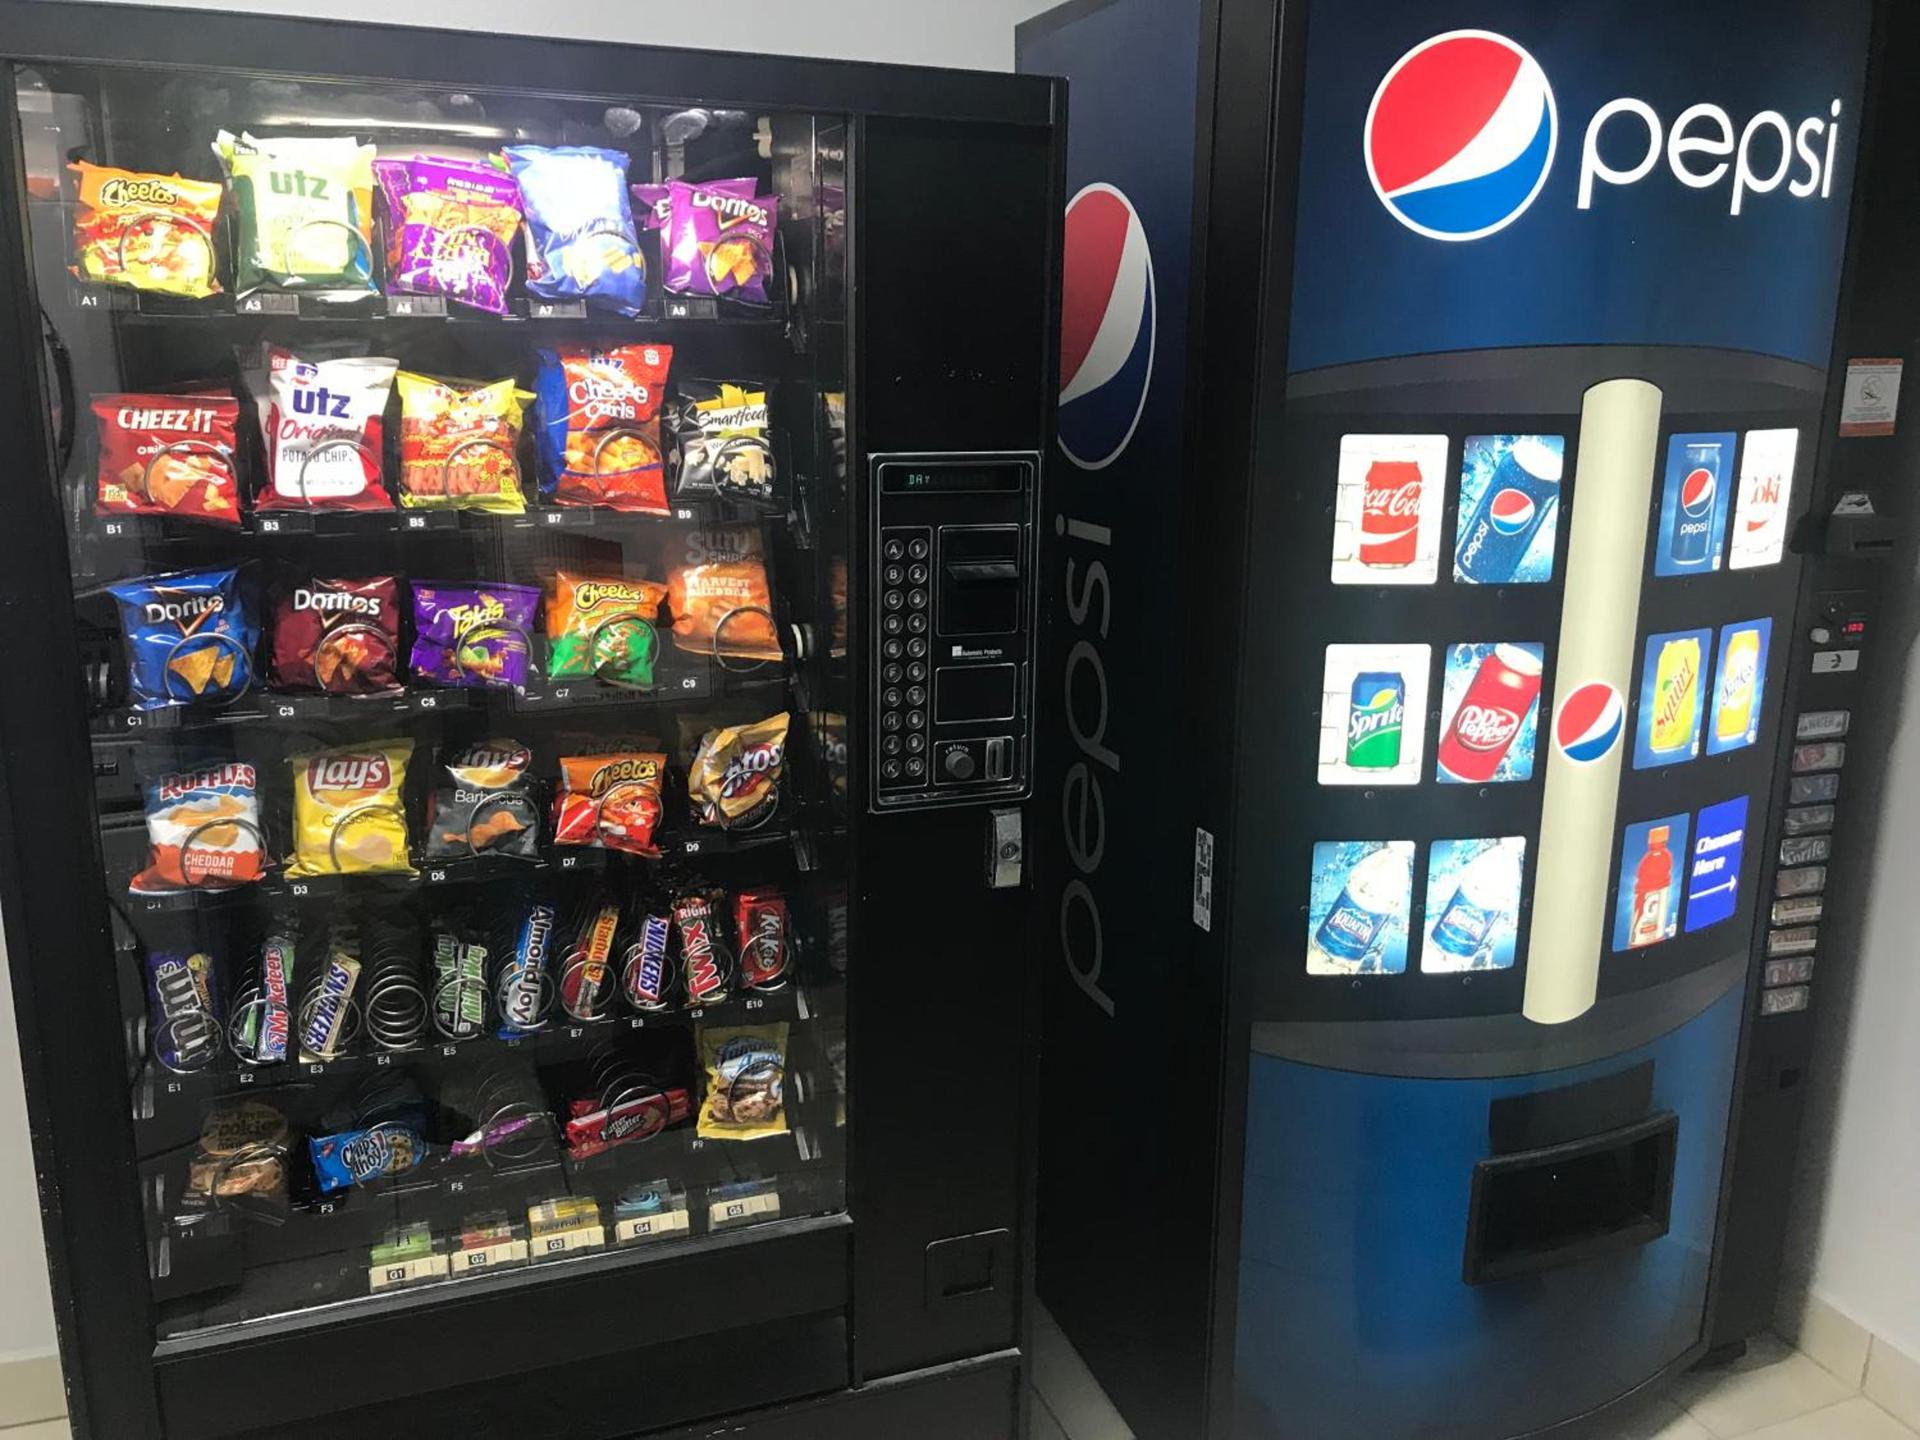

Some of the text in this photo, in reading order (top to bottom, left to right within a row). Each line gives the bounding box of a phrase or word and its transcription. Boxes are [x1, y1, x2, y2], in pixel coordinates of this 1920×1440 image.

[1577, 97, 1841, 216] pepsi
[269, 170, 329, 201] utz
[102, 178, 178, 207] Cheetos
[692, 192, 768, 227] Doritos
[81, 296, 98, 306] A1
[245, 301, 262, 311] A3
[539, 305, 553, 316] A7
[672, 306, 687, 316] A9
[292, 387, 351, 419] utz
[547, 514, 562, 523] B7
[678, 510, 692, 519] B9
[263, 521, 280, 531] B3
[408, 518, 425, 527] B5
[106, 524, 122, 534] B1
[1680, 520, 1709, 536] pepsi
[1462, 519, 1490, 568] pepsi
[575, 582, 643, 610] Cheetos
[294, 589, 381, 616] Doritos
[682, 679, 697, 688] C9
[555, 688, 570, 697] C7
[421, 697, 436, 707] C5
[279, 707, 294, 716] C3
[127, 716, 142, 726] C1
[1348, 701, 1404, 738] Sprite
[1055, 513, 1120, 1018] pepsi
[312, 755, 385, 791] Lay's
[160, 762, 257, 801] RUFFLES
[591, 760, 658, 797] Cheetos
[686, 842, 700, 852] D9
[184, 853, 234, 868] CHEDDAR
[563, 858, 576, 867] D7
[1693, 856, 1726, 877] Here
[293, 886, 308, 895] D3
[641, 914, 667, 996] SNICKERS
[682, 920, 722, 997] TWIX
[513, 905, 555, 1022] Almond Joy
[746, 1000, 763, 1009] E10
[631, 1019, 644, 1028] E8
[570, 1029, 583, 1038] E7
[443, 1046, 457, 1056] E5
[377, 1056, 391, 1065] E4
[310, 1064, 324, 1074] E3
[240, 1074, 254, 1083] E2
[168, 1083, 182, 1092] E1
[342, 1137, 378, 1168] Chips
[451, 1183, 464, 1191] F5
[321, 1204, 334, 1214] F3
[729, 1206, 742, 1215] G5
[636, 1224, 650, 1233] G4
[550, 1240, 563, 1249] G3
[471, 1255, 485, 1264] G2
[389, 1269, 403, 1279] G1
